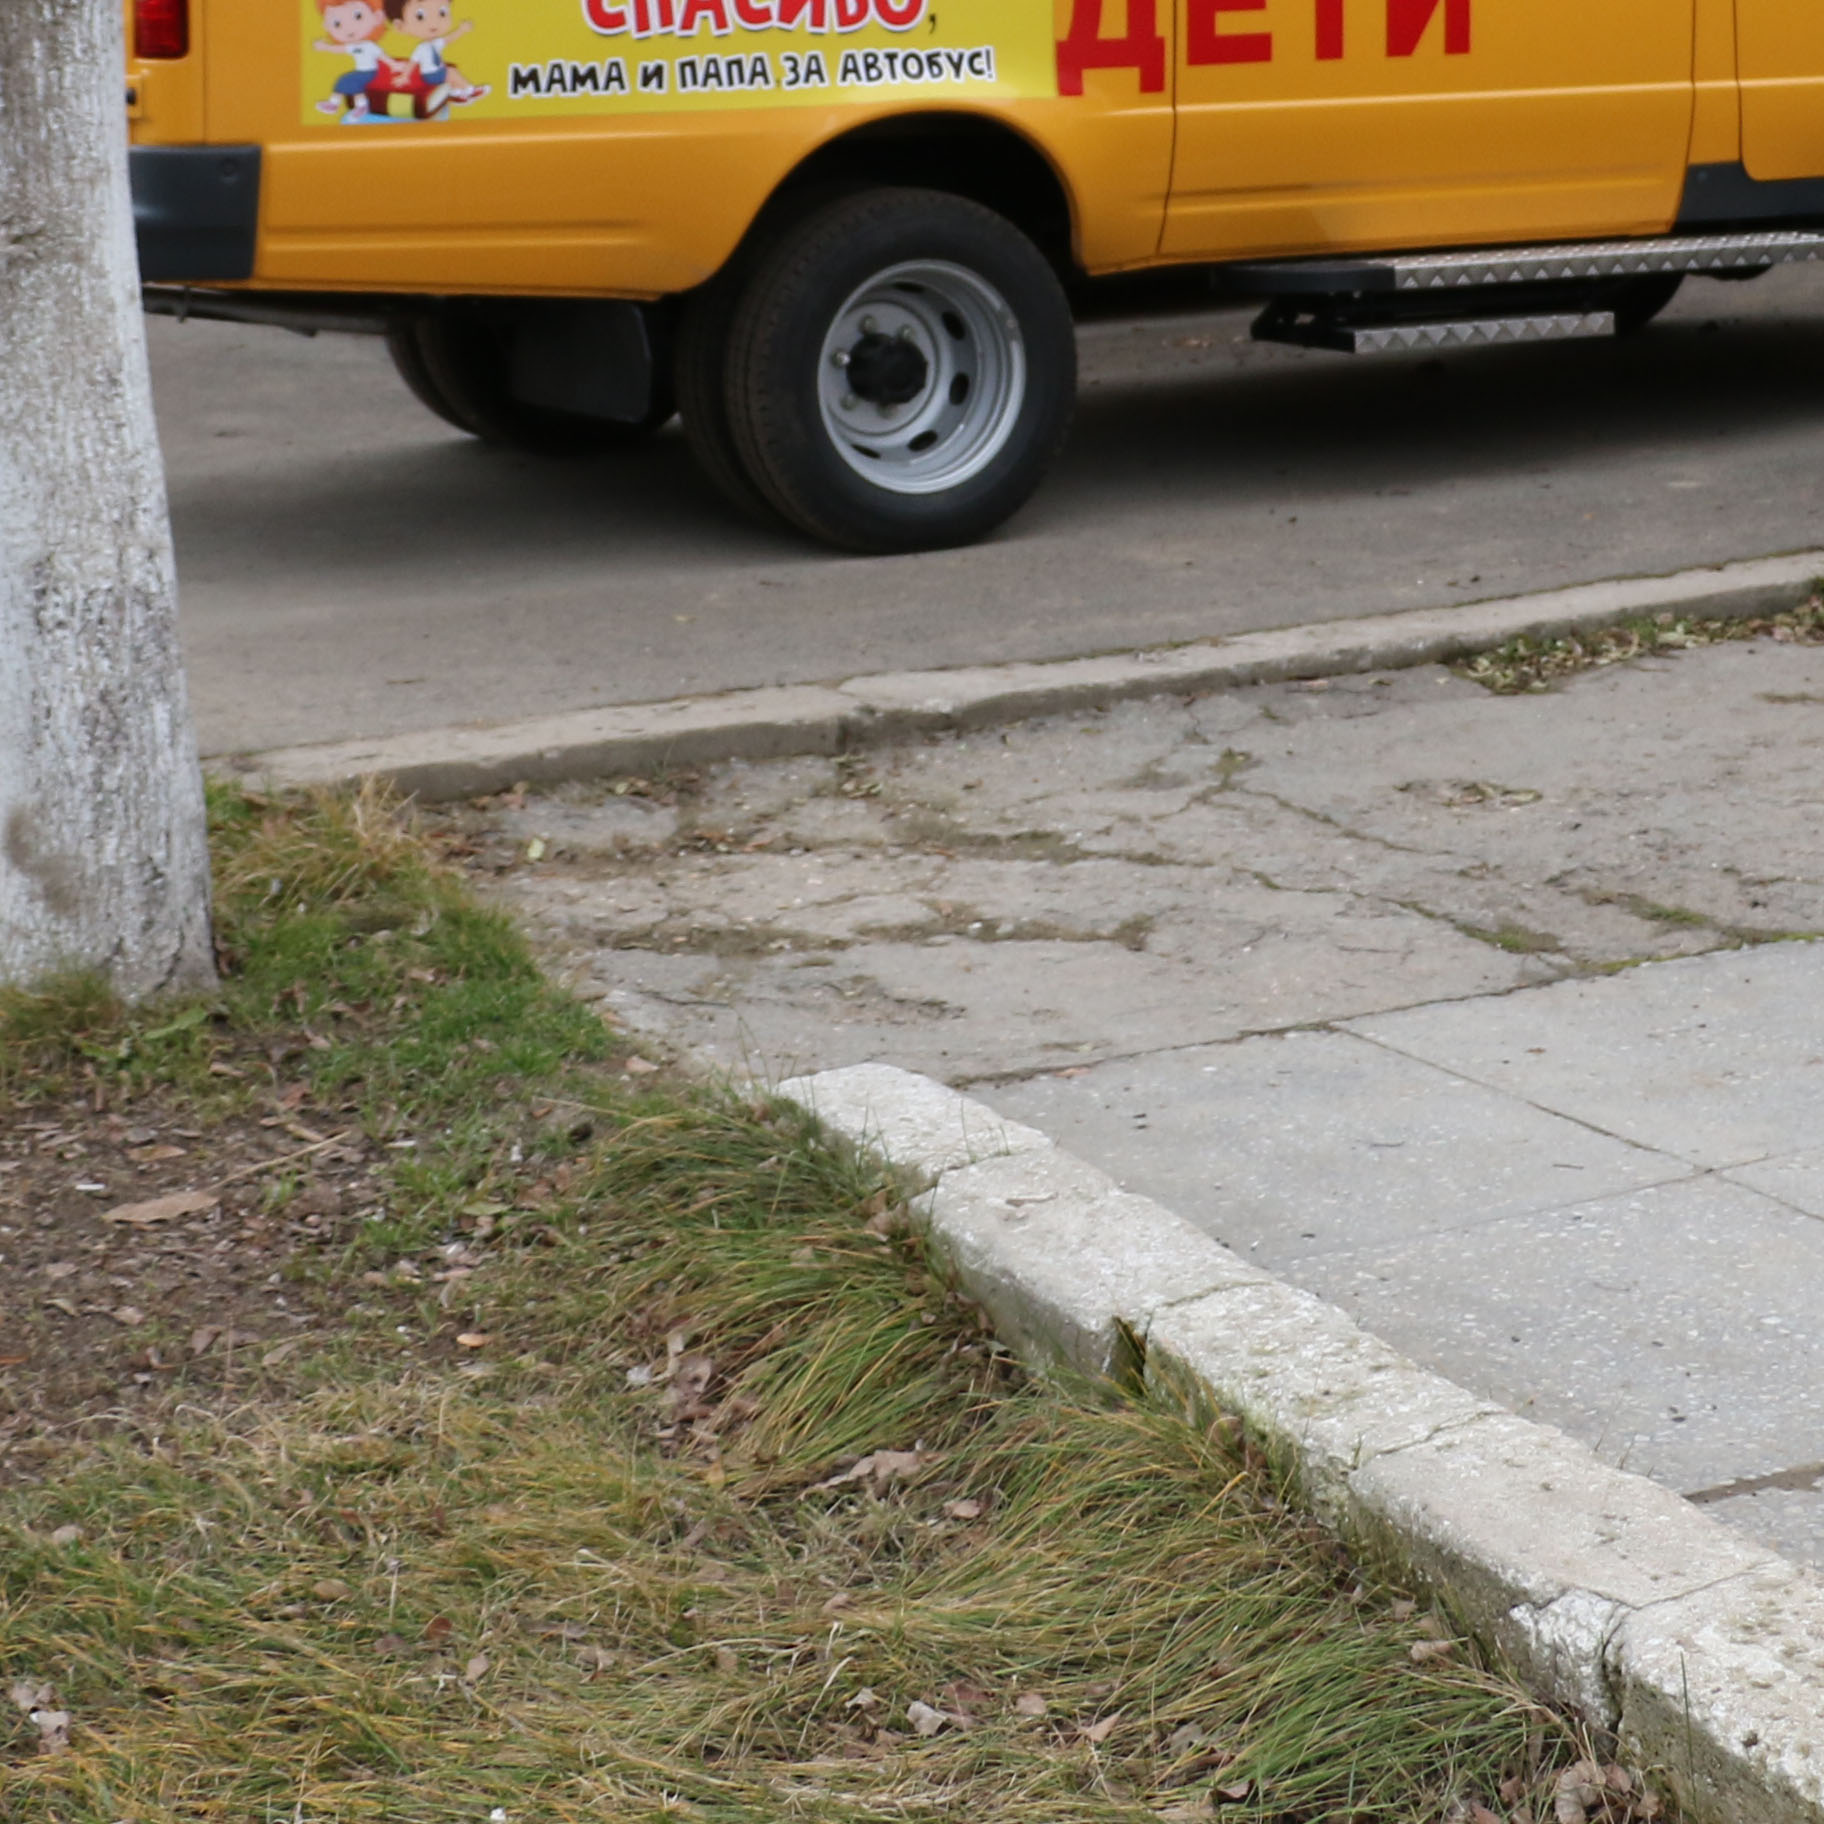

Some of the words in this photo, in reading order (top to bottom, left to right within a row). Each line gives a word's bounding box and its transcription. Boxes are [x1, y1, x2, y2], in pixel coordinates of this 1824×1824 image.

[510, 60, 627, 95] МАМА
[640, 62, 665, 91] И
[782, 52, 827, 87] ЗА
[840, 47, 993, 82] АВТОБУС!
